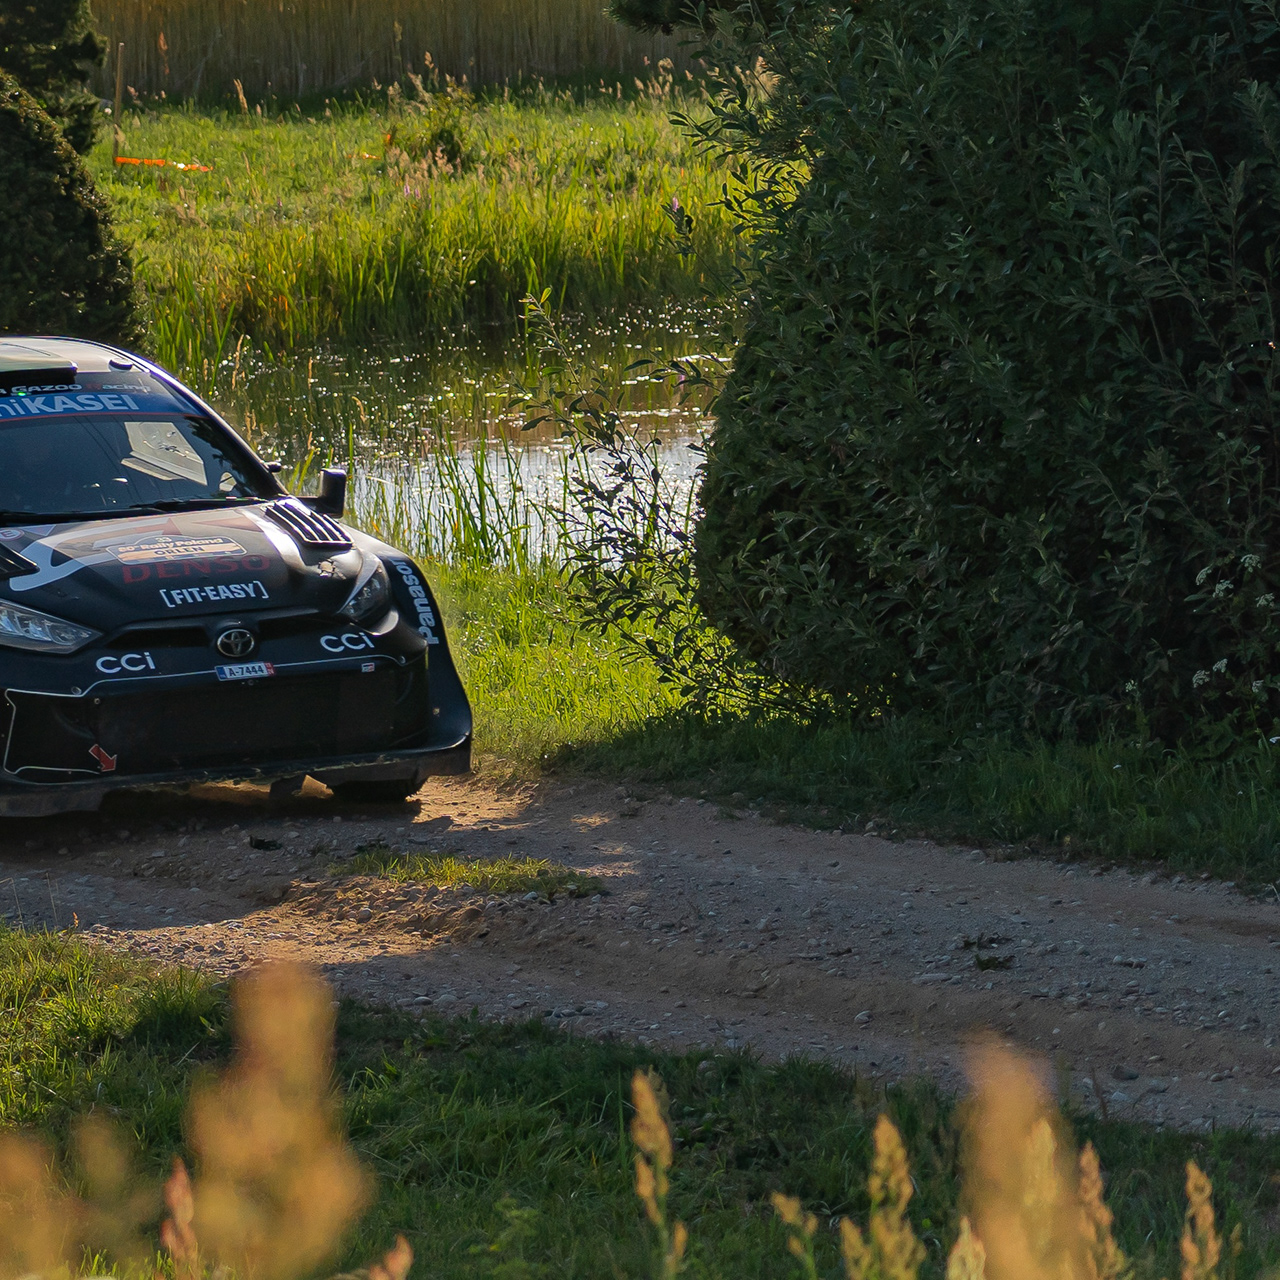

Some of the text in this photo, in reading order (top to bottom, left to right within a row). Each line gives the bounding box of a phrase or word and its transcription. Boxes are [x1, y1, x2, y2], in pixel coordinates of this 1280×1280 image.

[11, 384, 83, 393] GAZOO
[140, 542, 174, 550] Rally
[175, 538, 223, 546] Poland
[154, 546, 205, 555] ORLEN
[123, 554, 271, 584] DENSO
[228, 664, 265, 677] A-7444
